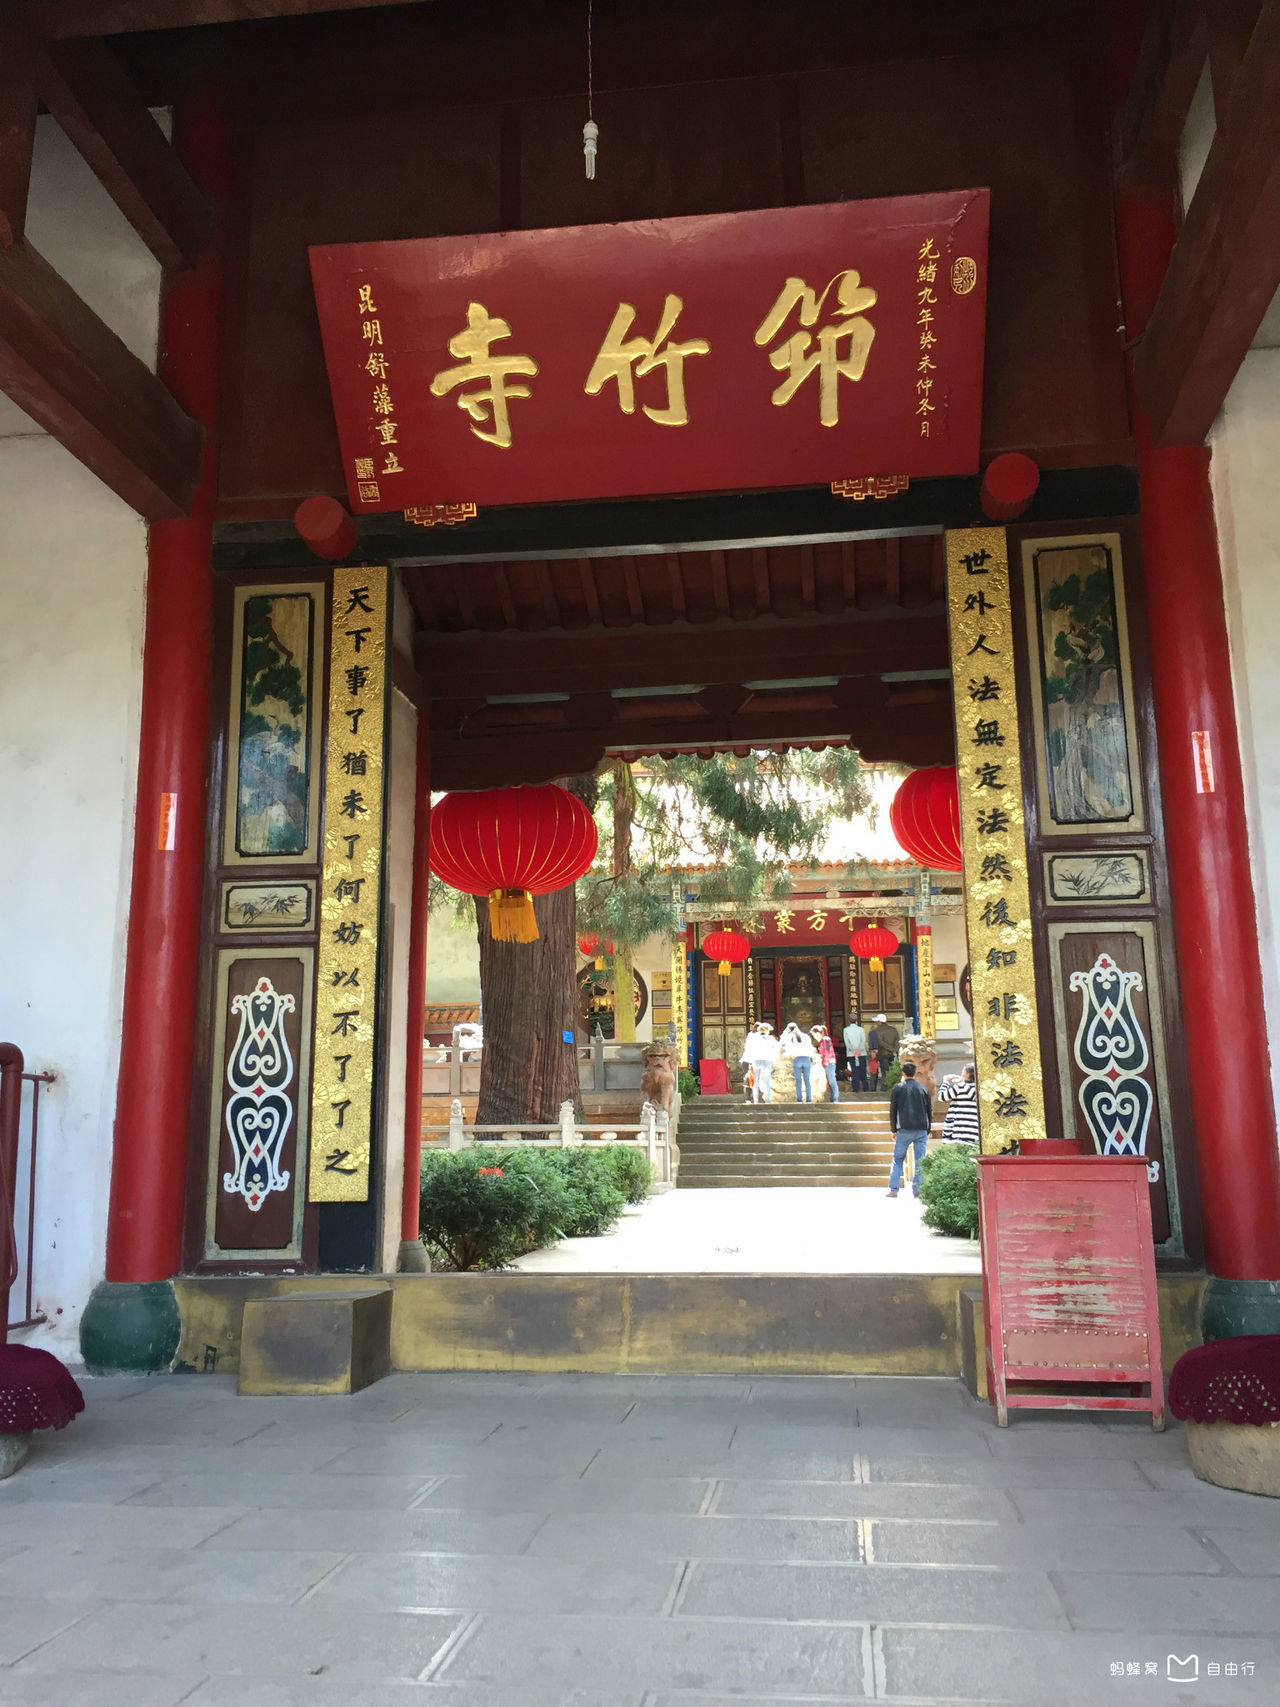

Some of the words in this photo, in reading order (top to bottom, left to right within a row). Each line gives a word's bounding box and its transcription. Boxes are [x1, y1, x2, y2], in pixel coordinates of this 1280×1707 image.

[324, 586, 375, 1176] 天下事了猶未了何妨以不了了之
